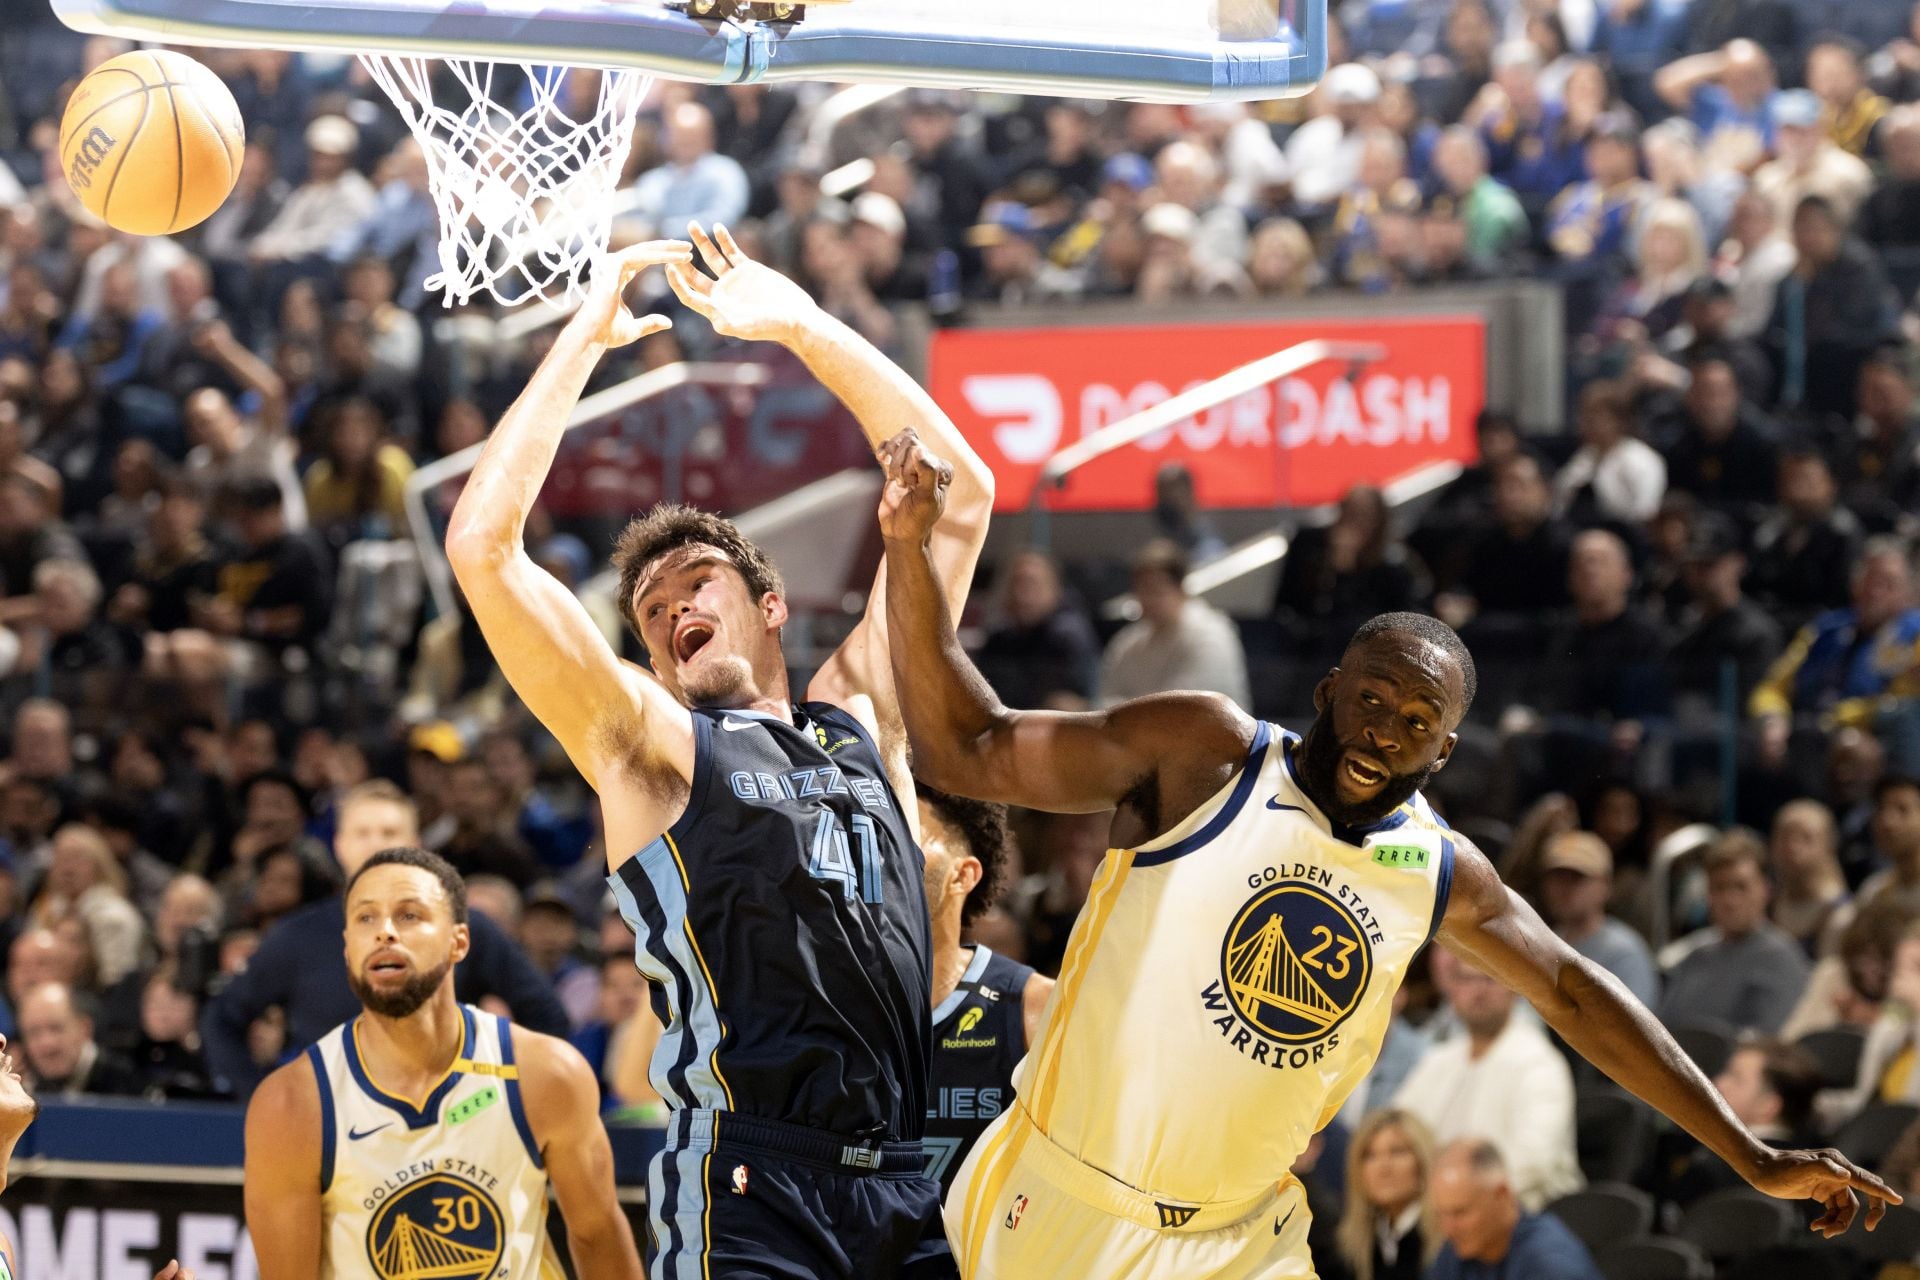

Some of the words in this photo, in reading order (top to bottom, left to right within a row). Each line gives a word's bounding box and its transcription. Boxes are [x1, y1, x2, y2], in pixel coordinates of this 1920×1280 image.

[730, 767, 890, 809] GRIZZES
[808, 810, 883, 904] 41
[1377, 849, 1425, 862] IREN
[1248, 863, 1333, 889] GOLDEN
[1338, 884, 1384, 946] STATE
[1301, 925, 1359, 981] 23
[942, 1036, 996, 1049] Robinhood
[1200, 979, 1340, 1070] WARRIORS
[363, 1159, 435, 1212] GOLDEN
[444, 1158, 499, 1191] STATE
[432, 1195, 481, 1235] 30
